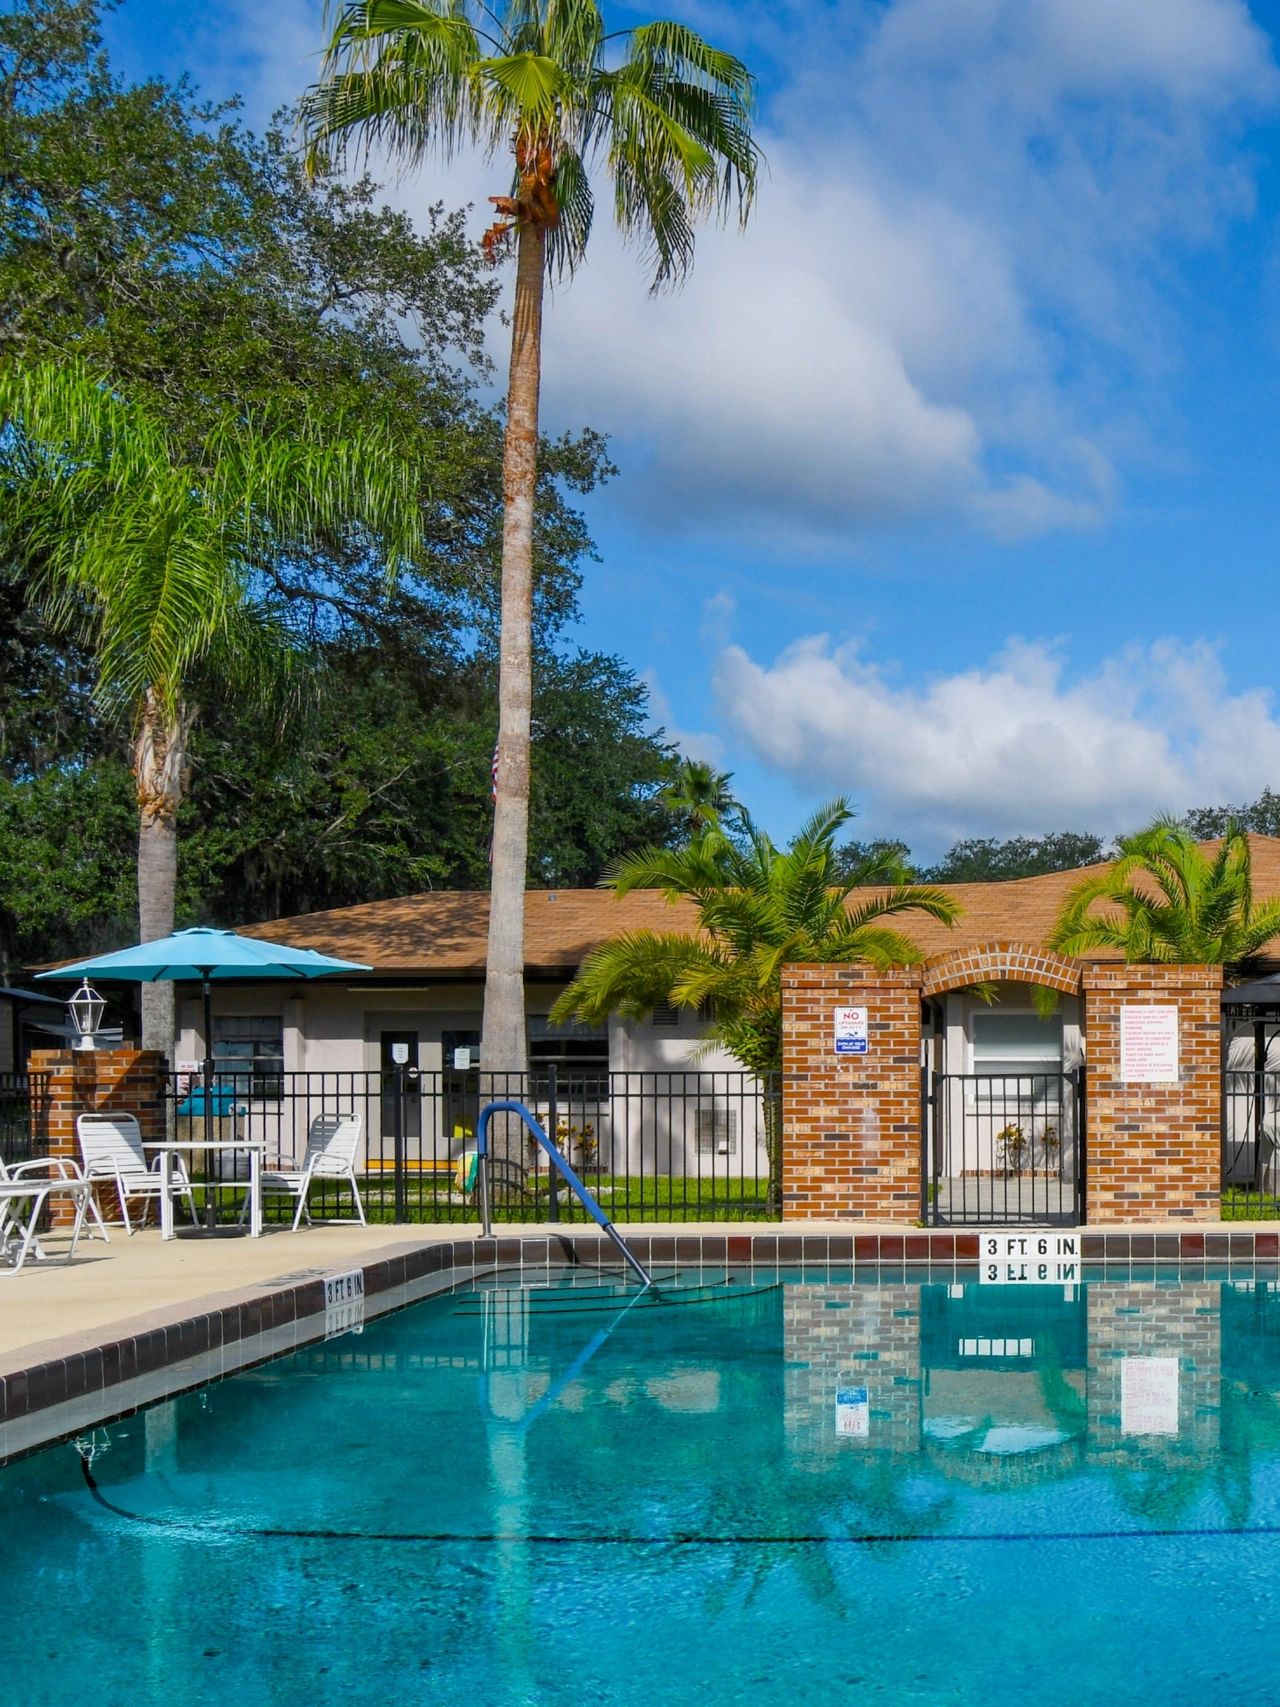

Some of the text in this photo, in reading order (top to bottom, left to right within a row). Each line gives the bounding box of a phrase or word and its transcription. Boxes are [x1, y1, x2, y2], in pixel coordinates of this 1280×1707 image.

[843, 1012, 859, 1020] NO
[988, 1239, 1078, 1255] 3 FT. 6 IN.
[327, 1283, 333, 1303] 3
[346, 1277, 352, 1298] 6
